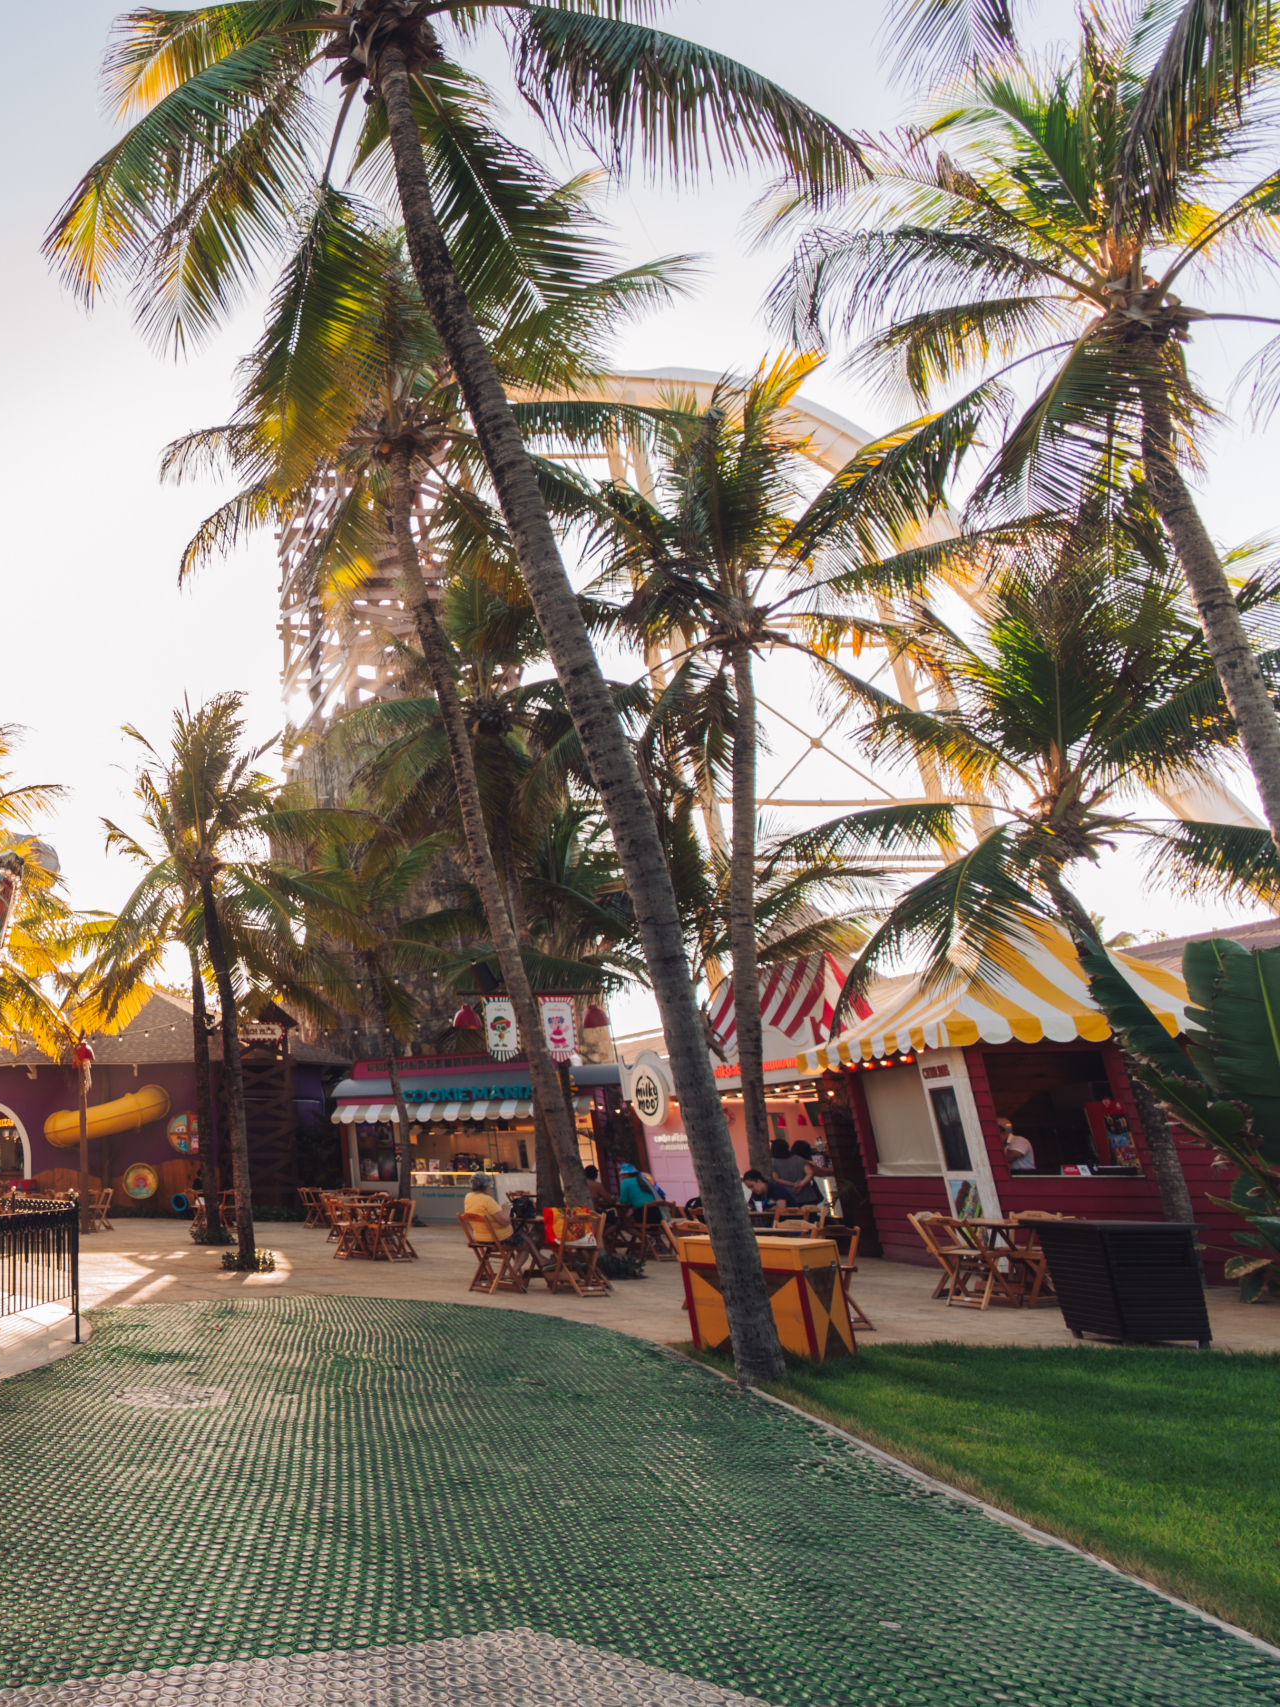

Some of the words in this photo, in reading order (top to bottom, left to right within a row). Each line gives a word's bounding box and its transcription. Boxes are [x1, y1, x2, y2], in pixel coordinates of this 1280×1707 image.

[402, 1087, 470, 1103] COOKIE
[635, 1081, 658, 1101] milky
[638, 1099, 657, 1111] moo
